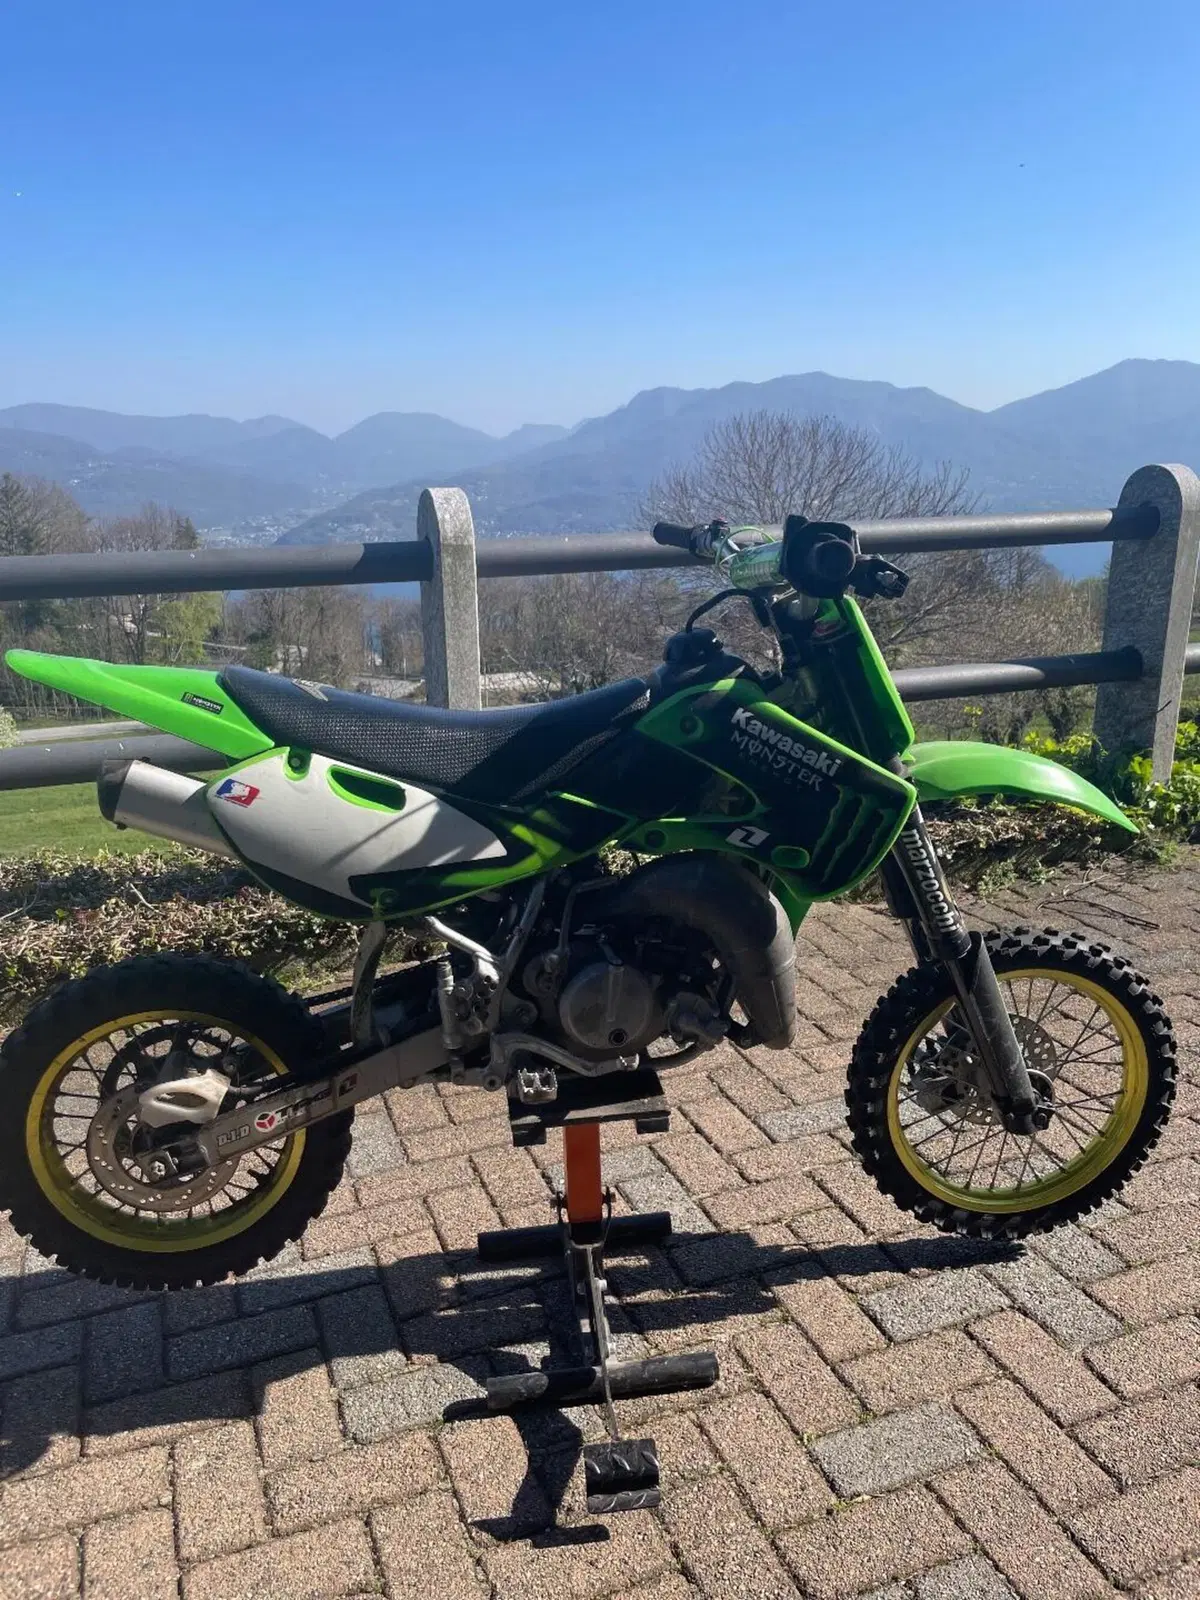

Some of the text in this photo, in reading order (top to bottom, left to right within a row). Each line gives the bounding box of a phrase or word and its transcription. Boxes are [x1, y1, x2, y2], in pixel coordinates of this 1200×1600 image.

[731, 707, 842, 777] Kawasaki
[731, 730, 824, 792] MONSTER
[900, 828, 963, 933] marzocchi
